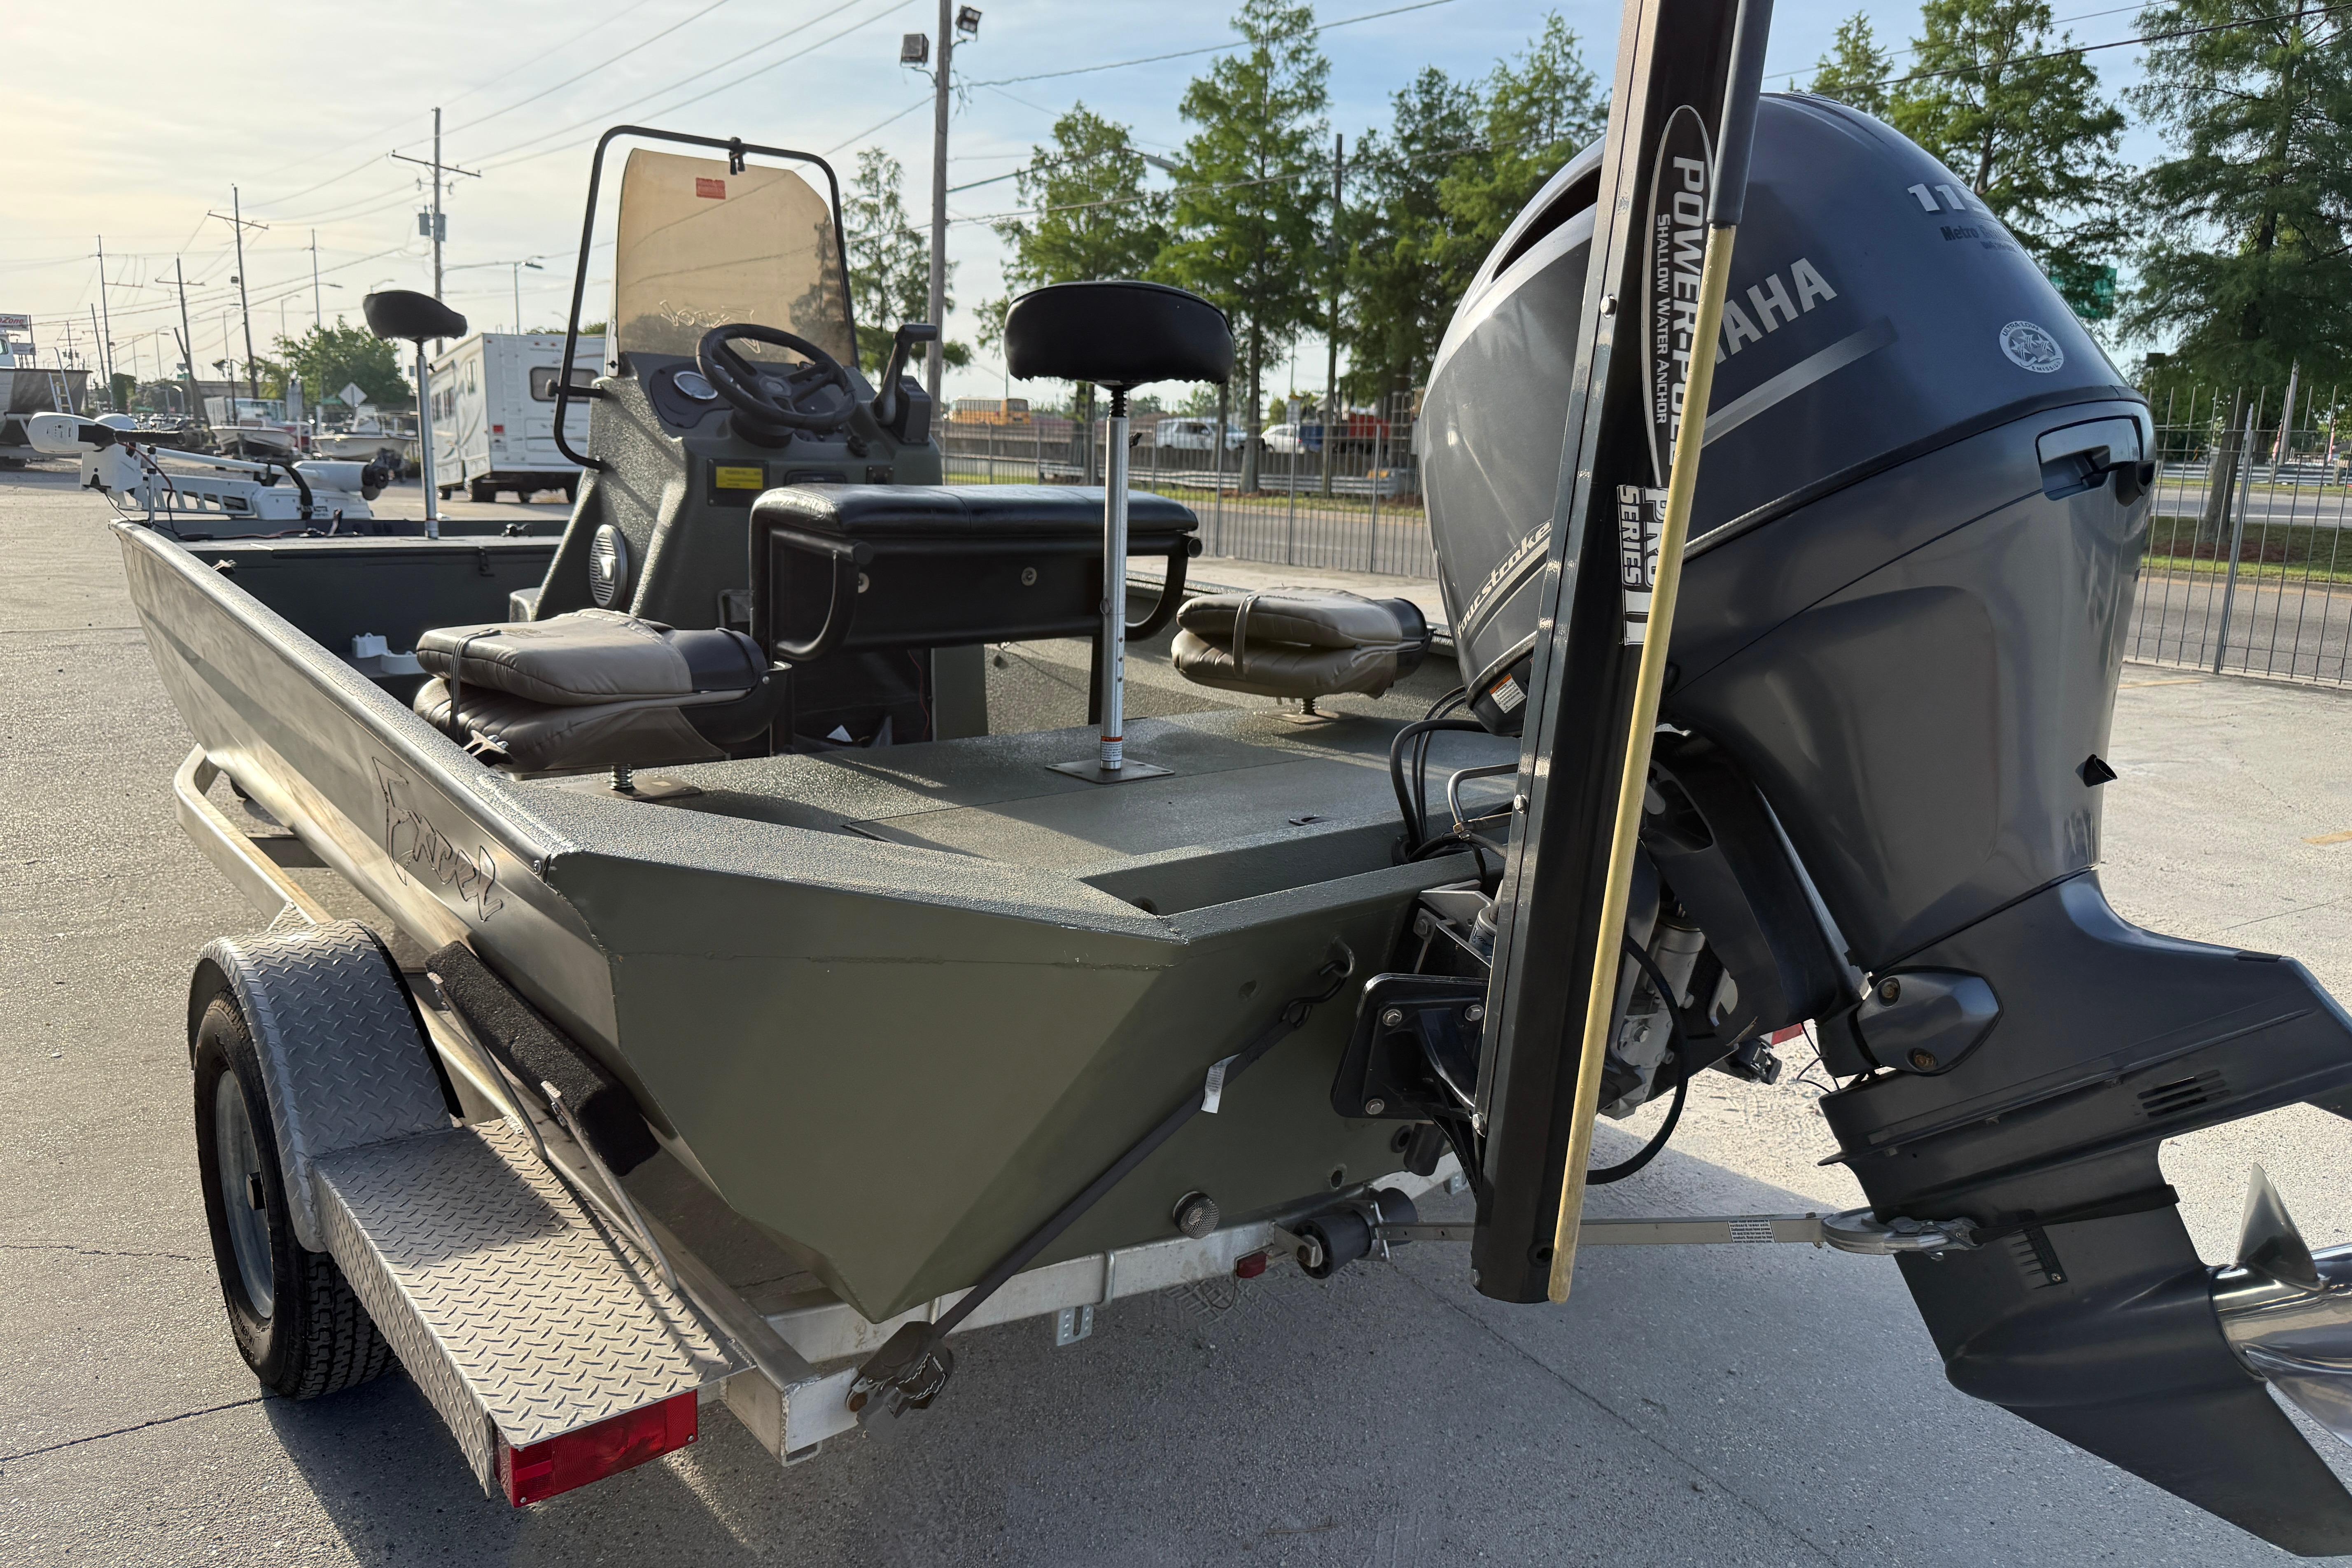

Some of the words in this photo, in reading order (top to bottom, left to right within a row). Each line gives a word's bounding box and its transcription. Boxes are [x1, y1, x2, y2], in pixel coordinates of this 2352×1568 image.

[1657, 213, 1671, 293] SHALLOW
[1939, 225, 1979, 242] Metro
[1657, 297, 1671, 355] WATER
[1715, 257, 1838, 365] AHA
[1656, 359, 1670, 424] ANCHOR
[1620, 486, 1641, 586] SERIES
